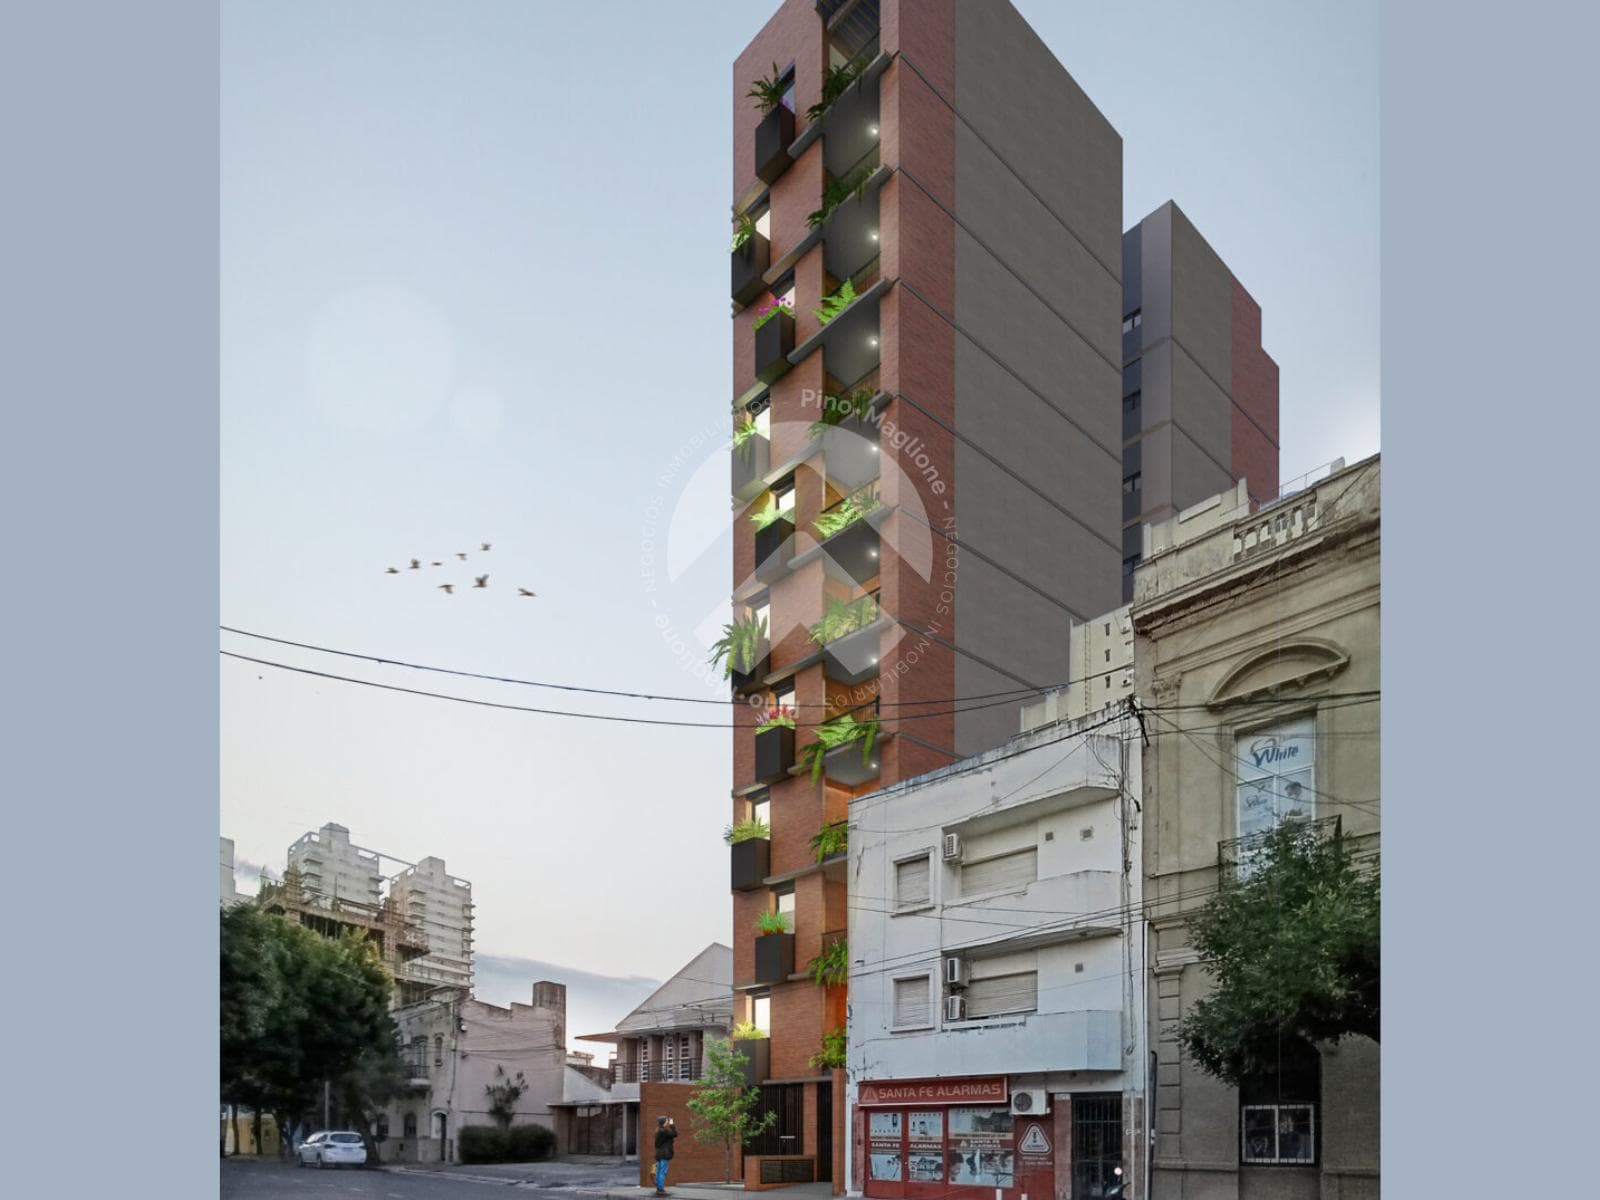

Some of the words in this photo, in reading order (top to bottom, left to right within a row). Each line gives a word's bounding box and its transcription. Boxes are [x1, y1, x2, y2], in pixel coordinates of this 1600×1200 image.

[1252, 744, 1299, 768] White
[879, 1087, 916, 1099] SANTA
[919, 1086, 934, 1097] FE
[936, 1083, 1001, 1097] ALARMAS
